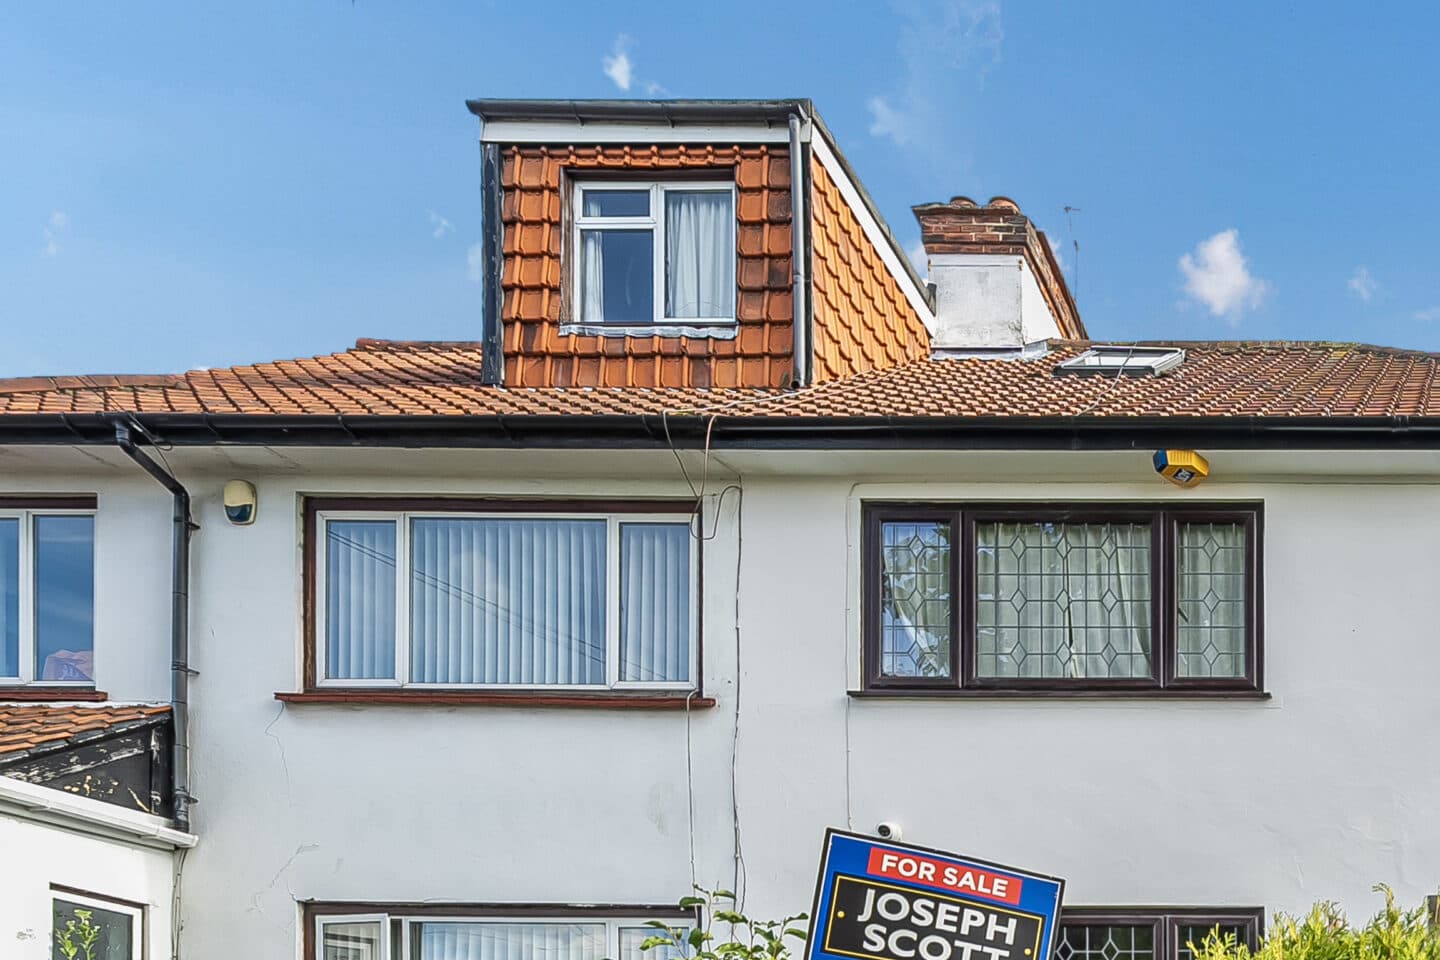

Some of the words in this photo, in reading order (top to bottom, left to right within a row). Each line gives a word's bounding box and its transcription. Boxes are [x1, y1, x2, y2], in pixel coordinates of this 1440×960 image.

[881, 854, 935, 882] FOR
[943, 867, 1008, 897] SALE
[857, 888, 1017, 945] JOSEPH
